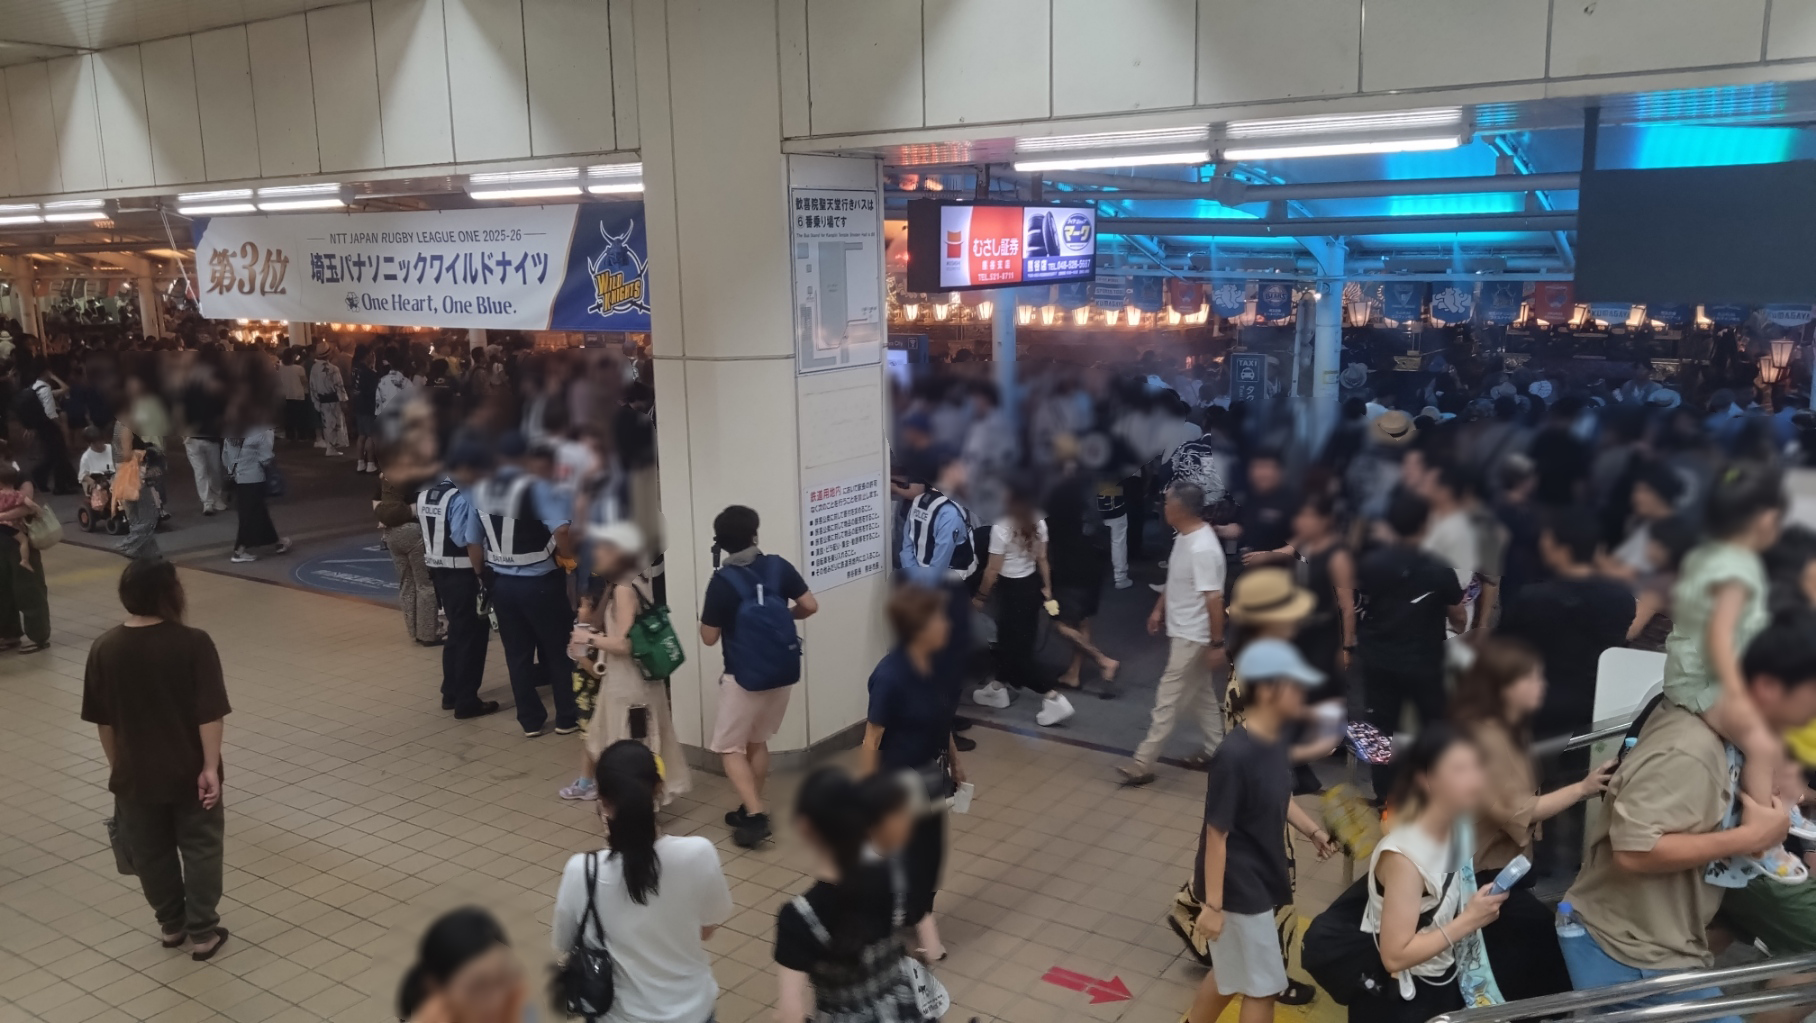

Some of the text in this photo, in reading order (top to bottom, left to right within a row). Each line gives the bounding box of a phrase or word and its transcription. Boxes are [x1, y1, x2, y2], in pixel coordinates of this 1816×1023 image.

[329, 229, 522, 245] NTT JAPAN RUGBY LEAGUE ONE 2025-26
[1064, 225, 1091, 242] マーク
[973, 238, 1019, 257] むさし証券
[206, 241, 290, 297] 第3位
[310, 250, 549, 286] 埼玉パナソニックワイルドナイツ
[595, 271, 624, 296] WILD
[361, 293, 517, 315] One Heart, One Blue.
[602, 279, 641, 312] KNIGHTS
[810, 485, 842, 503] 鉄道用地内
[421, 506, 442, 516] POLICE
[913, 508, 929, 522] POLICE
